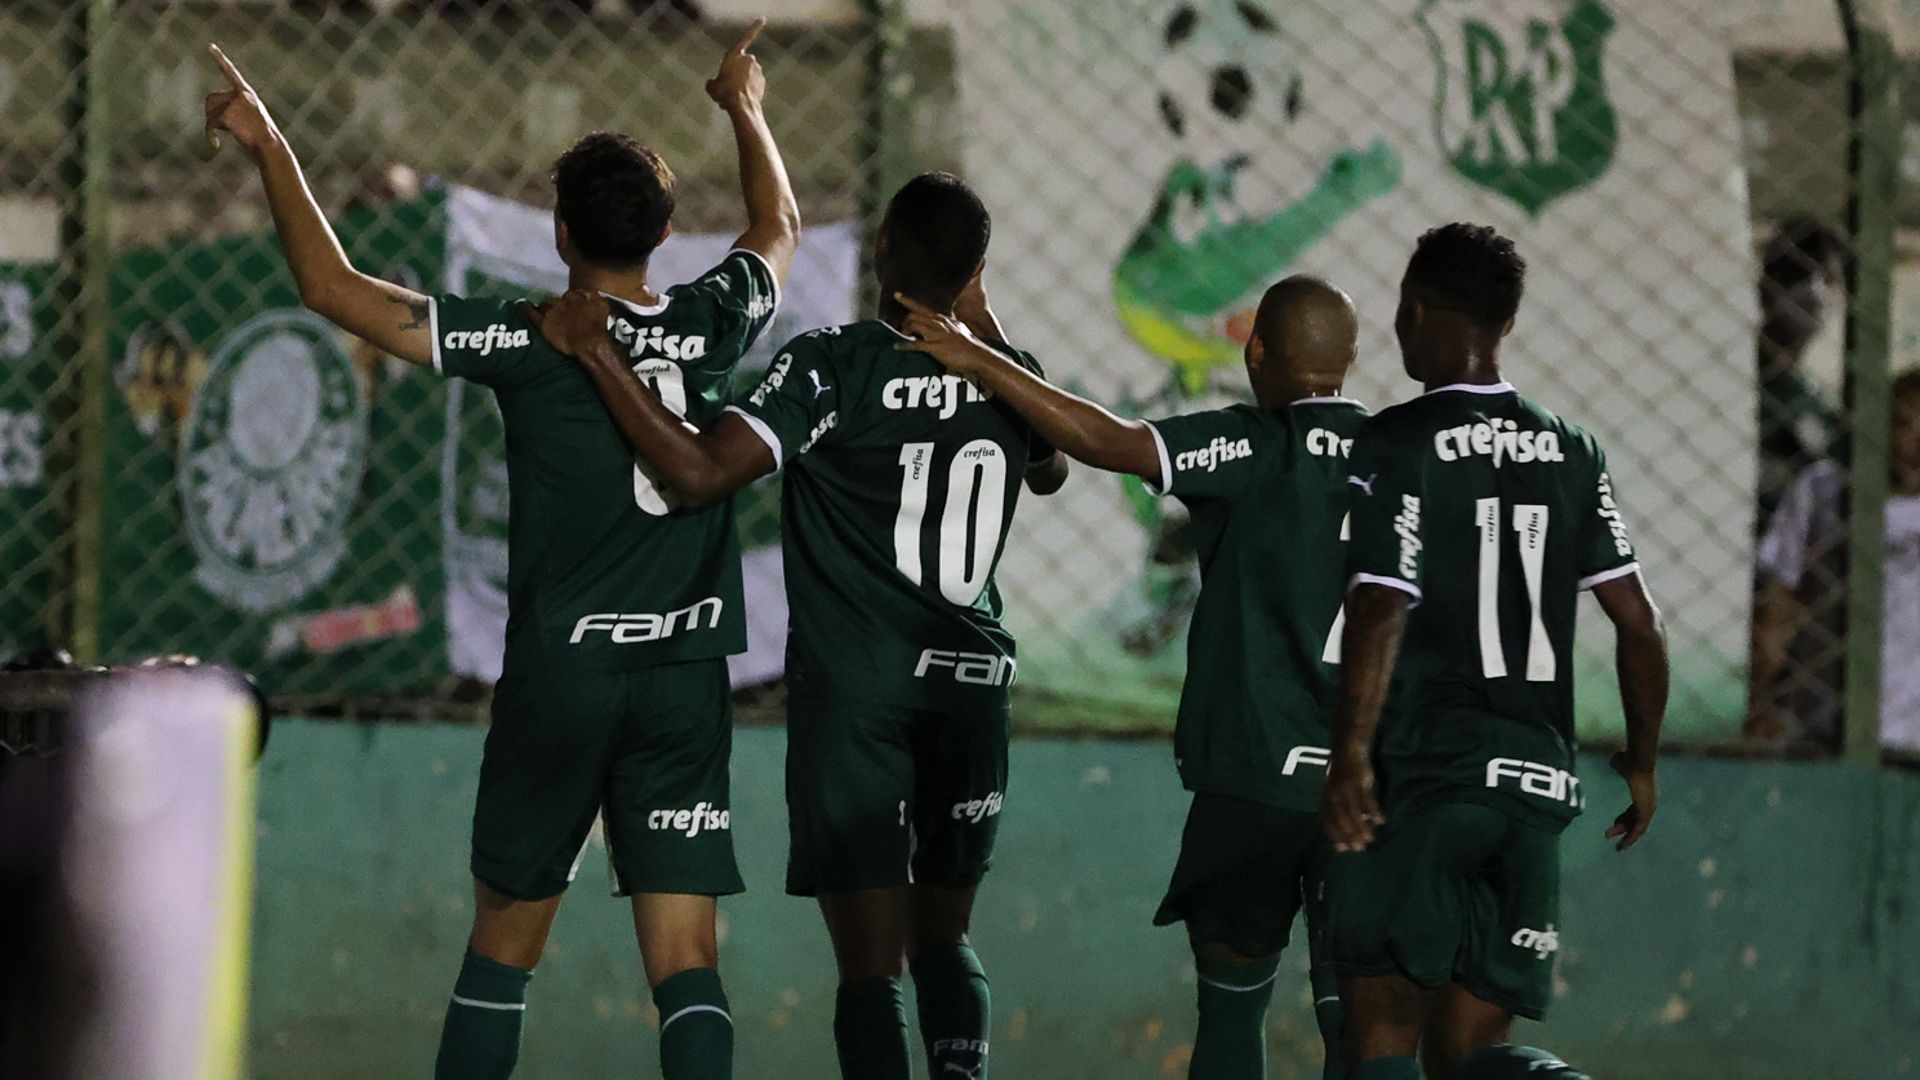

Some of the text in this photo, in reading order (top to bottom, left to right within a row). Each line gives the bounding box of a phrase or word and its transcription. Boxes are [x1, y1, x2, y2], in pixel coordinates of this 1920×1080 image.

[444, 324, 530, 356] crefisa
[963, 447, 996, 460] crefisa
[1176, 436, 1253, 472] crefisa
[1434, 417, 1565, 469] crefisa
[912, 448, 924, 480] crefisa
[893, 439, 1007, 607] 10
[1394, 494, 1423, 580] crefisa
[1527, 512, 1539, 550] crefisa
[1475, 496, 1557, 682] 11
[647, 801, 730, 838] crefisa
